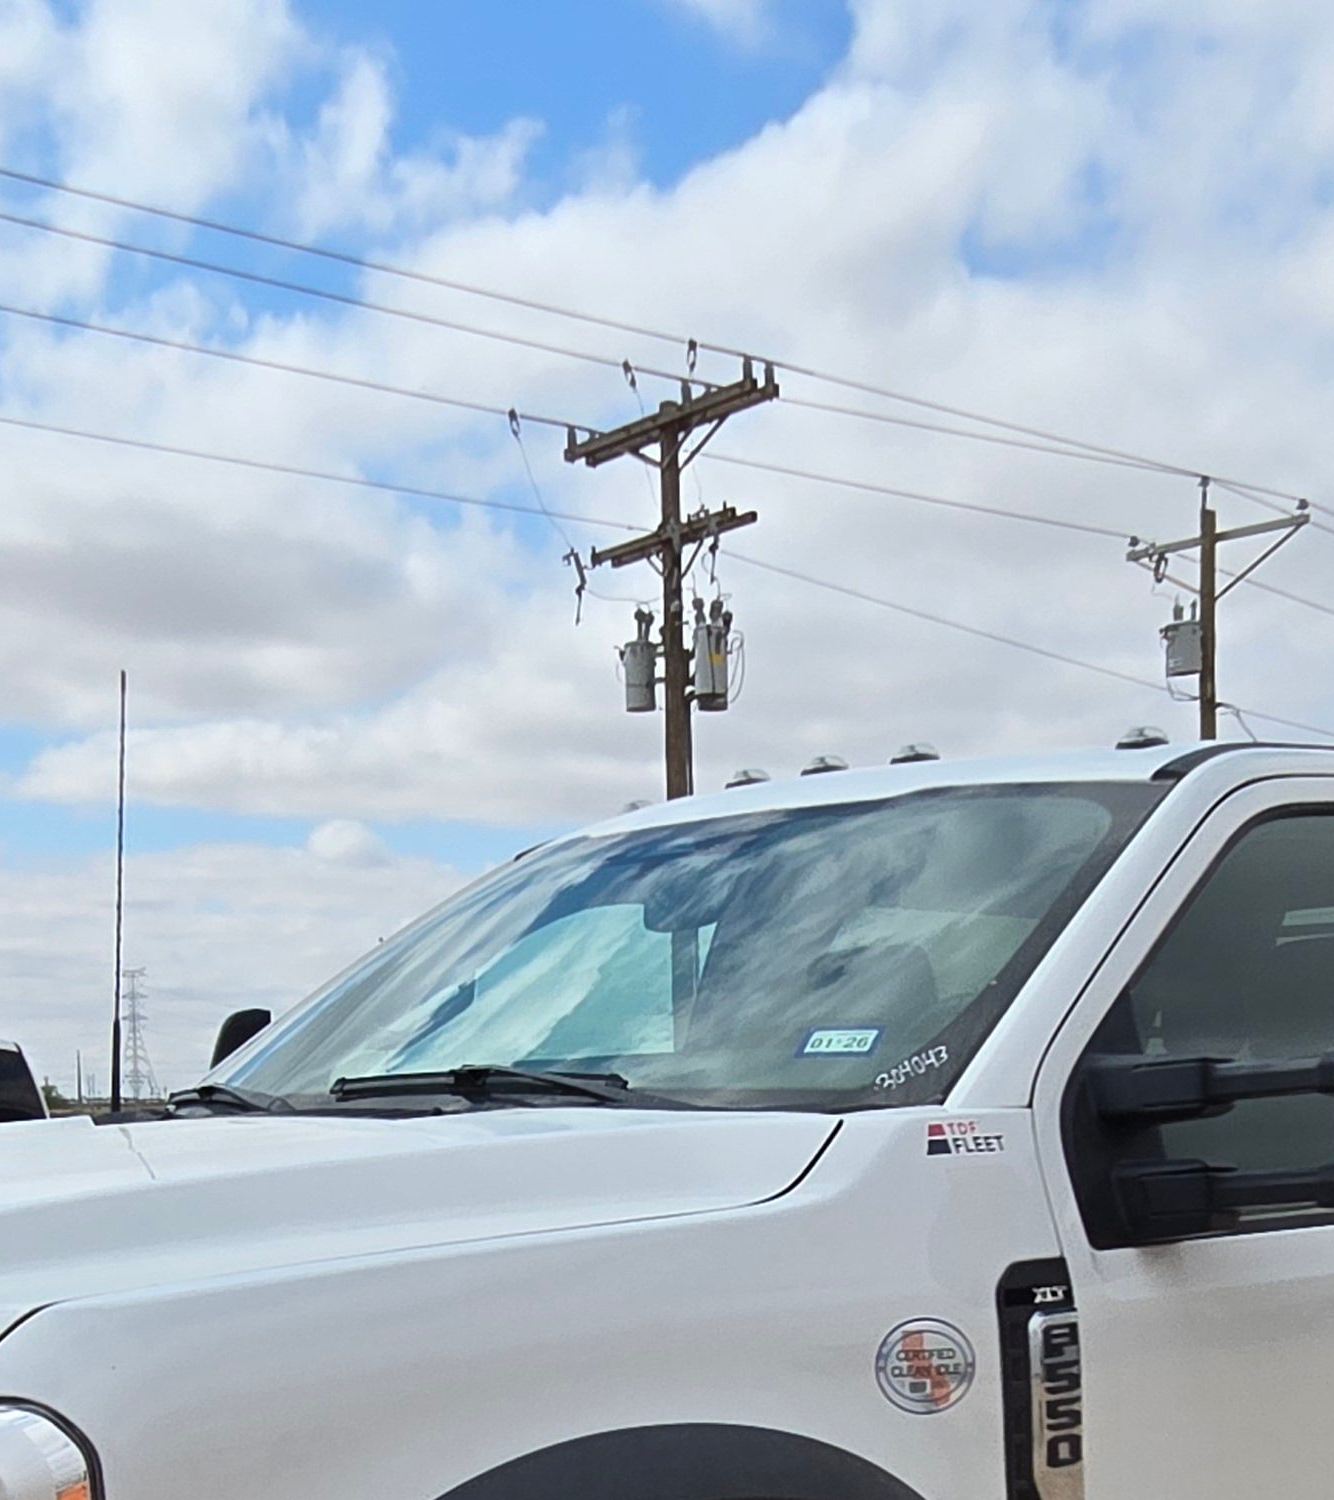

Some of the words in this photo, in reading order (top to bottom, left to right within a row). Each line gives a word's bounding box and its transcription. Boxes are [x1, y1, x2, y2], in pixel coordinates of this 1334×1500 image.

[946, 1120, 977, 1136] TDF
[952, 1134, 1005, 1154] FLEET
[1031, 1284, 1068, 1304] XLT
[895, 1347, 957, 1362] CERTIFIED
[890, 1364, 933, 1380] CLEAN
[934, 1362, 962, 1376] IDLE
